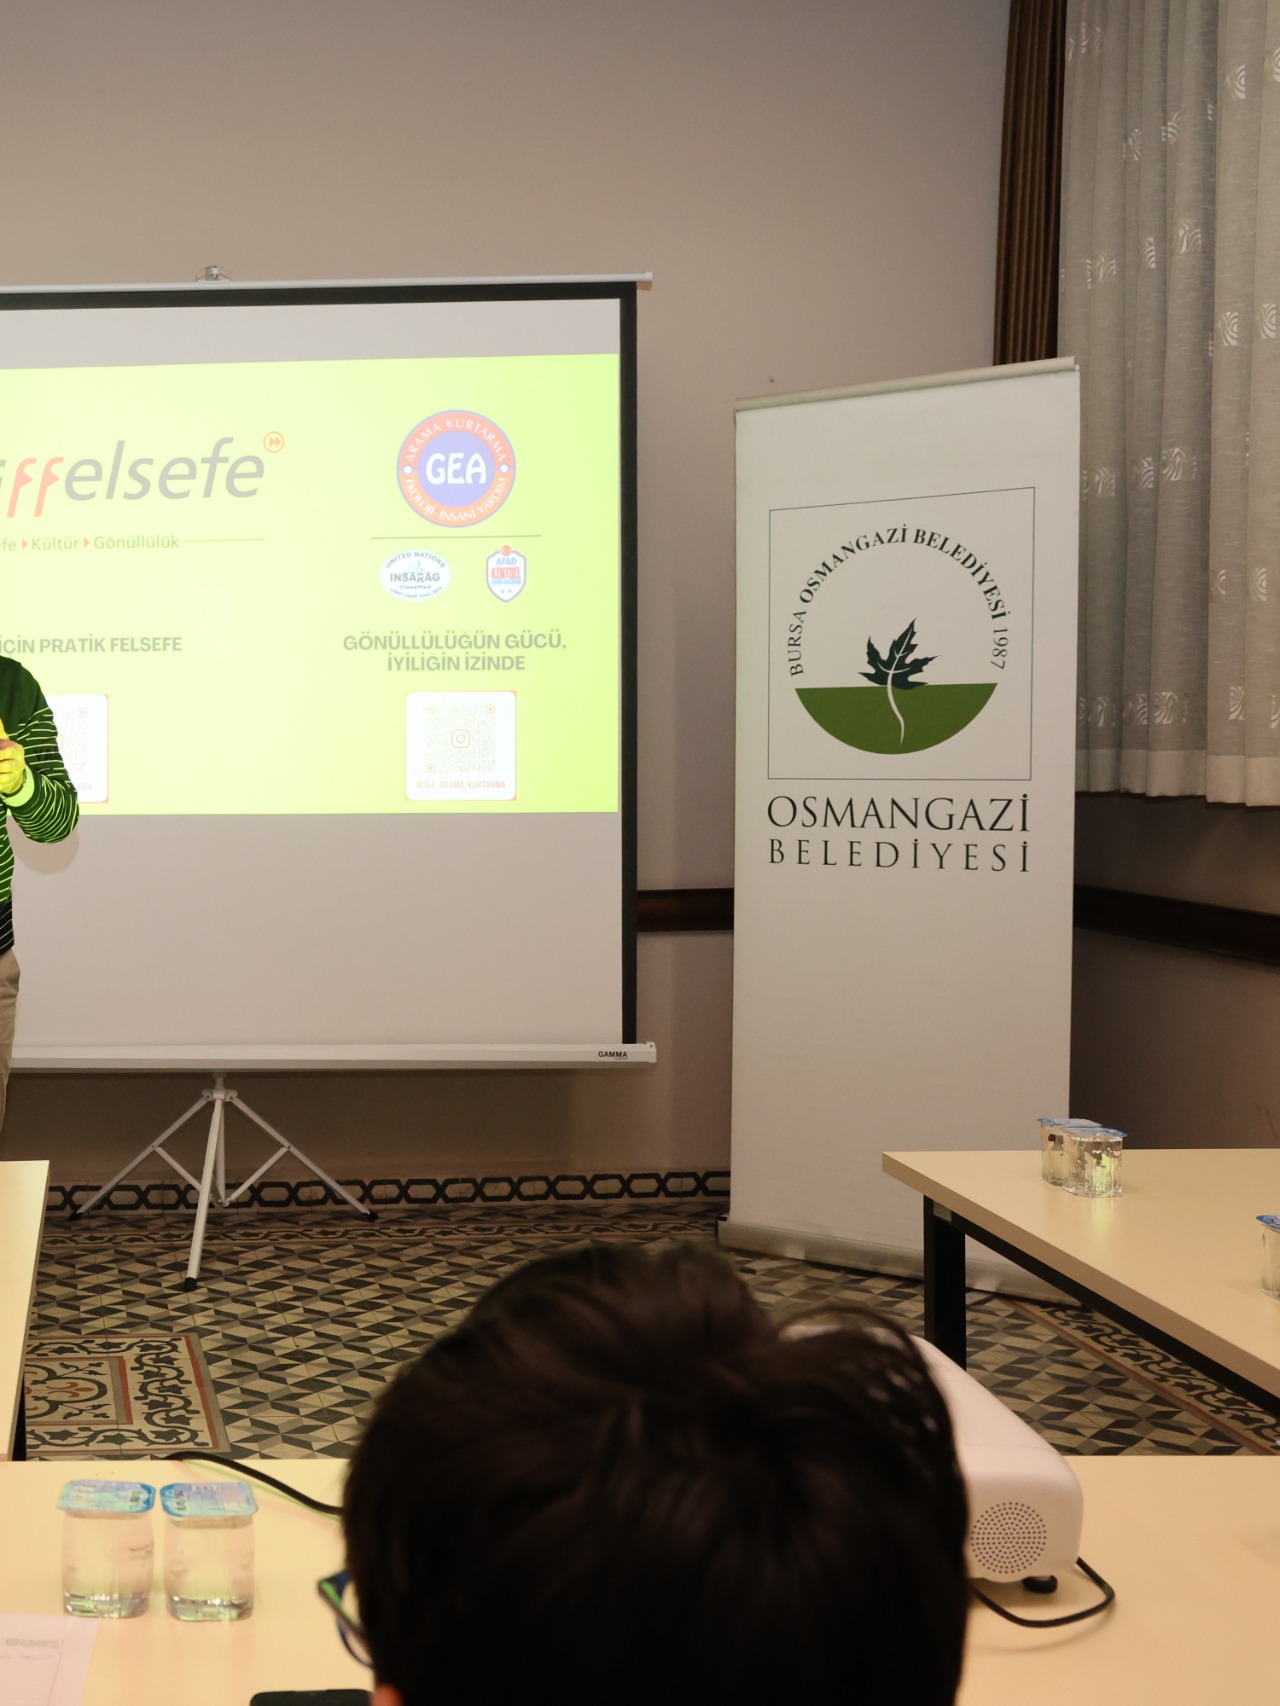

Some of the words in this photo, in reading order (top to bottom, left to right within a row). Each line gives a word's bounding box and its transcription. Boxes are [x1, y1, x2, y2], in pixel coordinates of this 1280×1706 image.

[406, 423, 442, 463] ARAMA
[446, 418, 507, 462] KURTARMA
[425, 452, 487, 485] GEA
[476, 477, 507, 514] YARDIM
[31, 537, 80, 551] Kültür
[94, 535, 180, 550] Gönüllülük
[385, 552, 412, 568] UNITED
[413, 551, 446, 568] NATIONS
[496, 557, 517, 565] AFAD
[390, 572, 440, 583] INSARAG
[787, 609, 807, 677] BURSA
[799, 524, 908, 604] OSMANGAZİ
[912, 528, 1011, 619] BELEDİYESİ
[990, 627, 1009, 670] 1987
[40, 633, 106, 653] PRATİK
[110, 637, 182, 652] FELSEFE
[343, 630, 500, 650] GÖNÜLLÜLÜĞÜN
[505, 629, 567, 651] GÜCÜ,
[465, 651, 526, 671] İZİNDE
[767, 793, 1030, 832] OSMANGAZİ
[769, 838, 1030, 872] BELEDİYESİ
